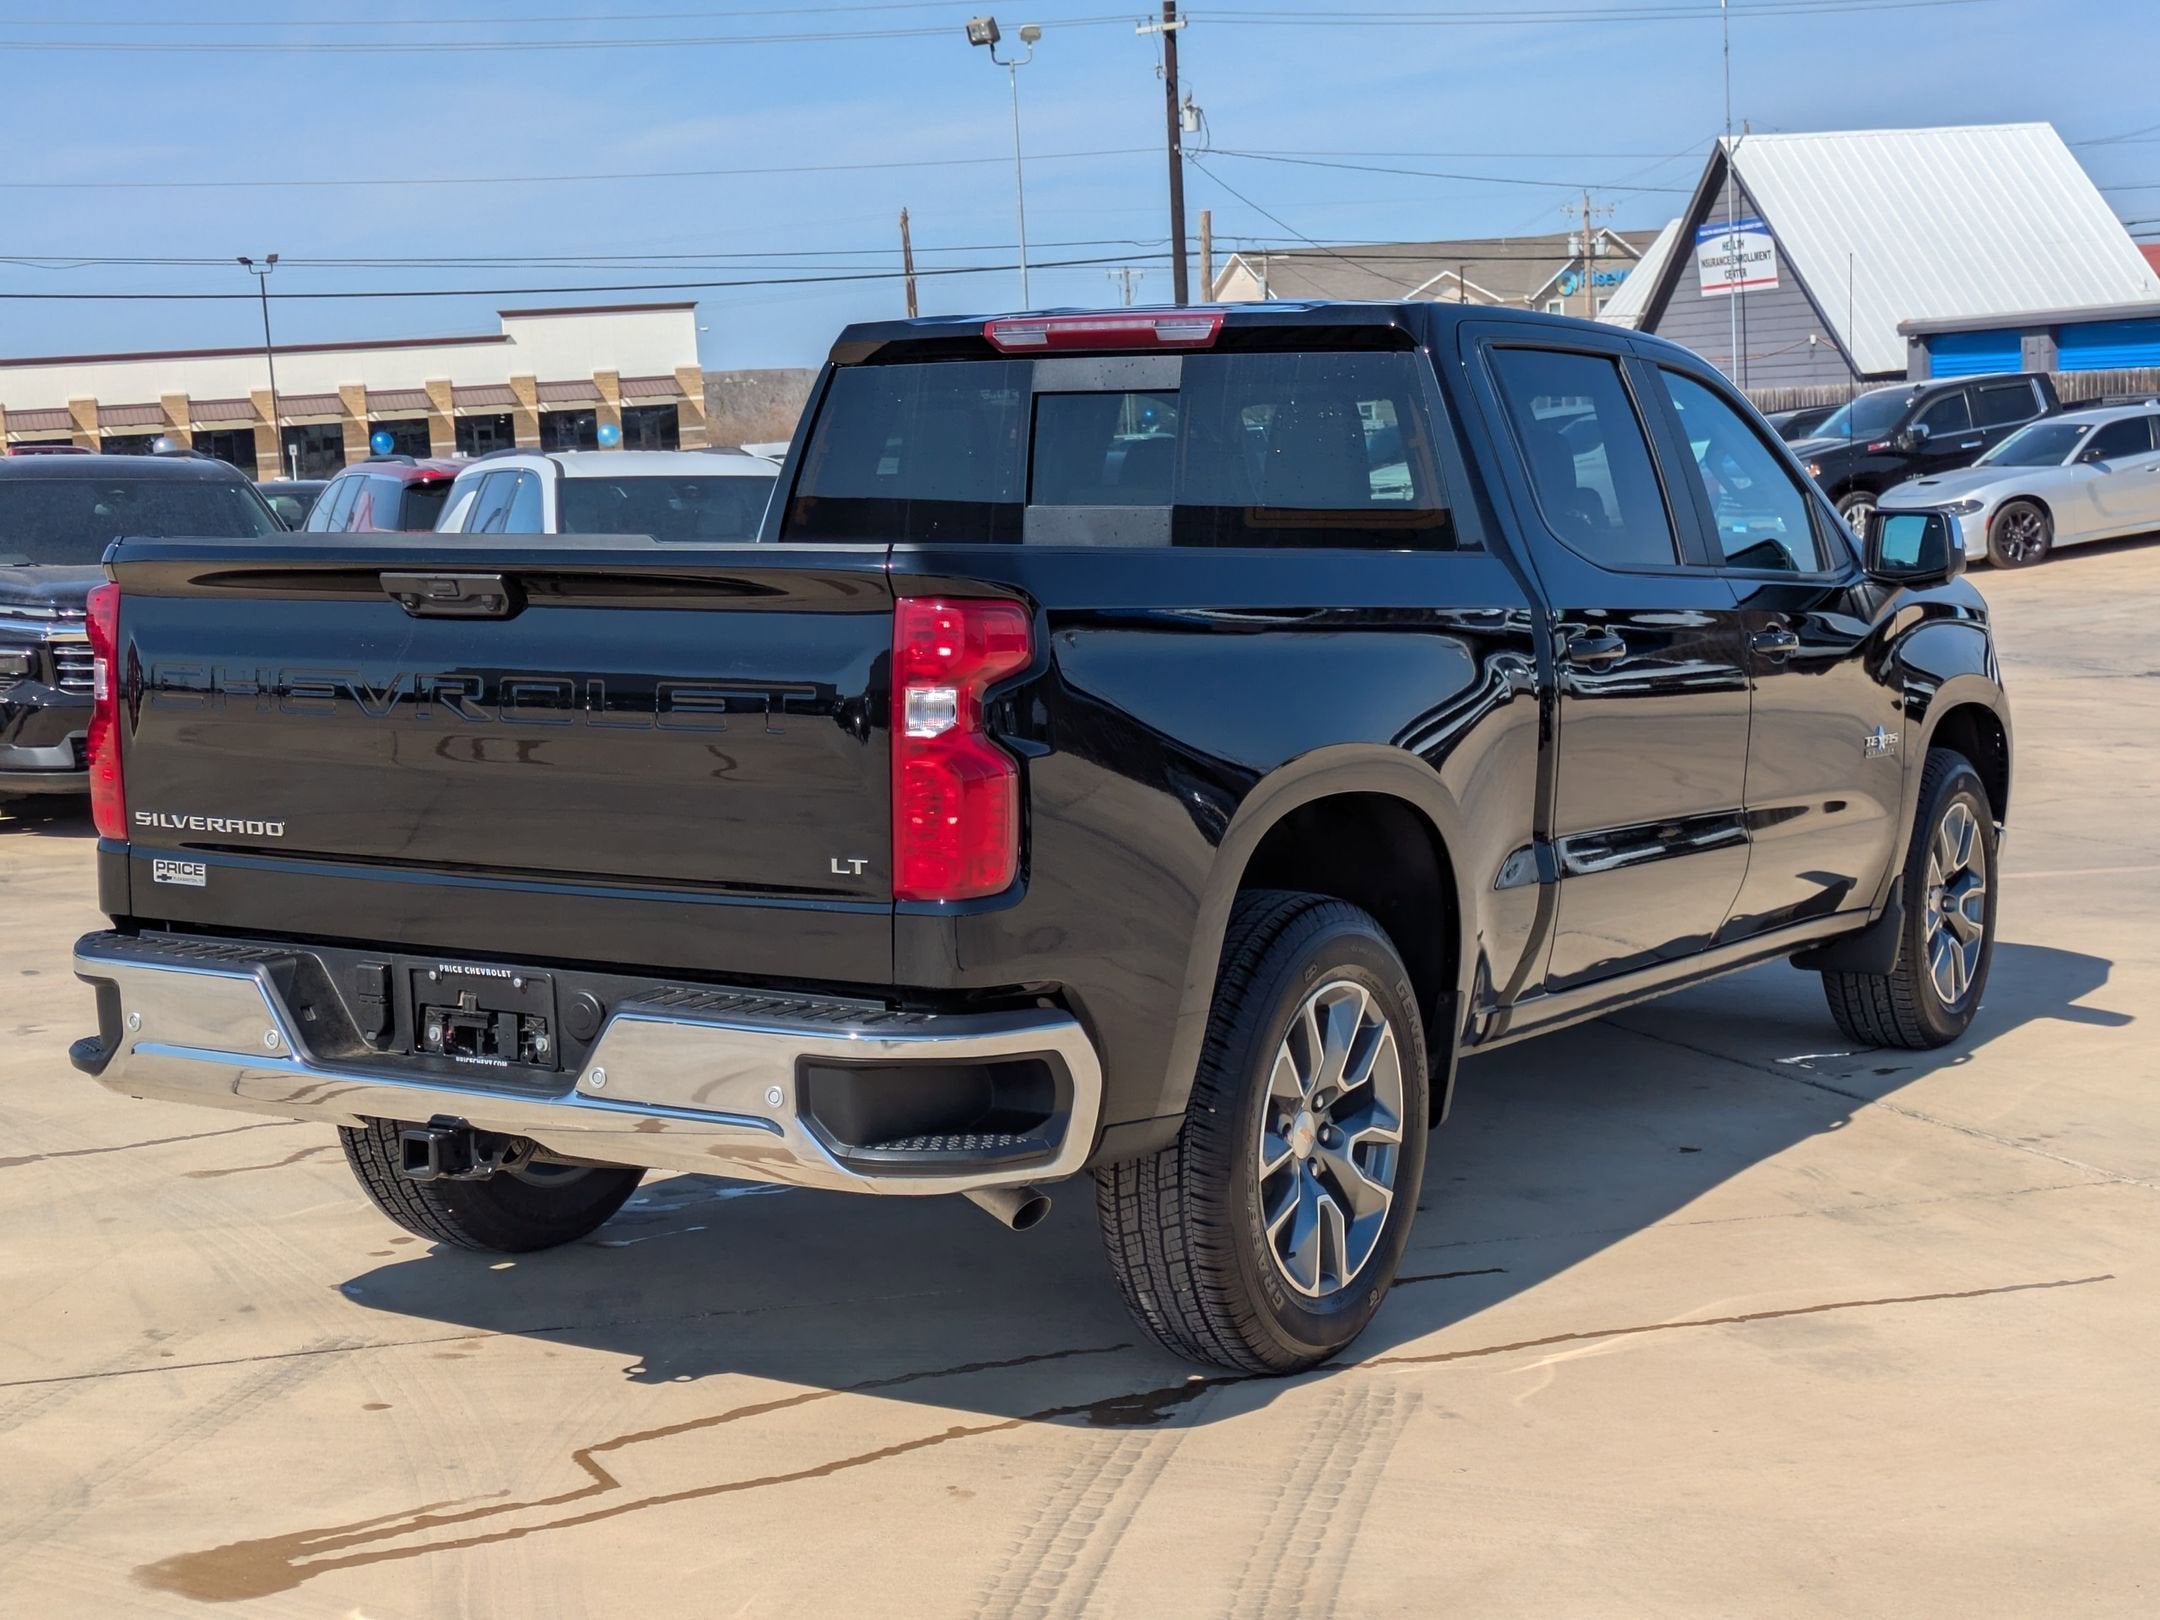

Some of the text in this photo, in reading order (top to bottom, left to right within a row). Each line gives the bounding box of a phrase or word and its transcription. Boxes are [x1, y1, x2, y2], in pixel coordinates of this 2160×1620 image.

[151, 662, 816, 734] CHEVROLET
[135, 811, 285, 837] SILVERADO
[156, 861, 204, 876] PRICE
[831, 858, 868, 875] LT
[439, 964, 511, 978] PRICE CHEVROLET
